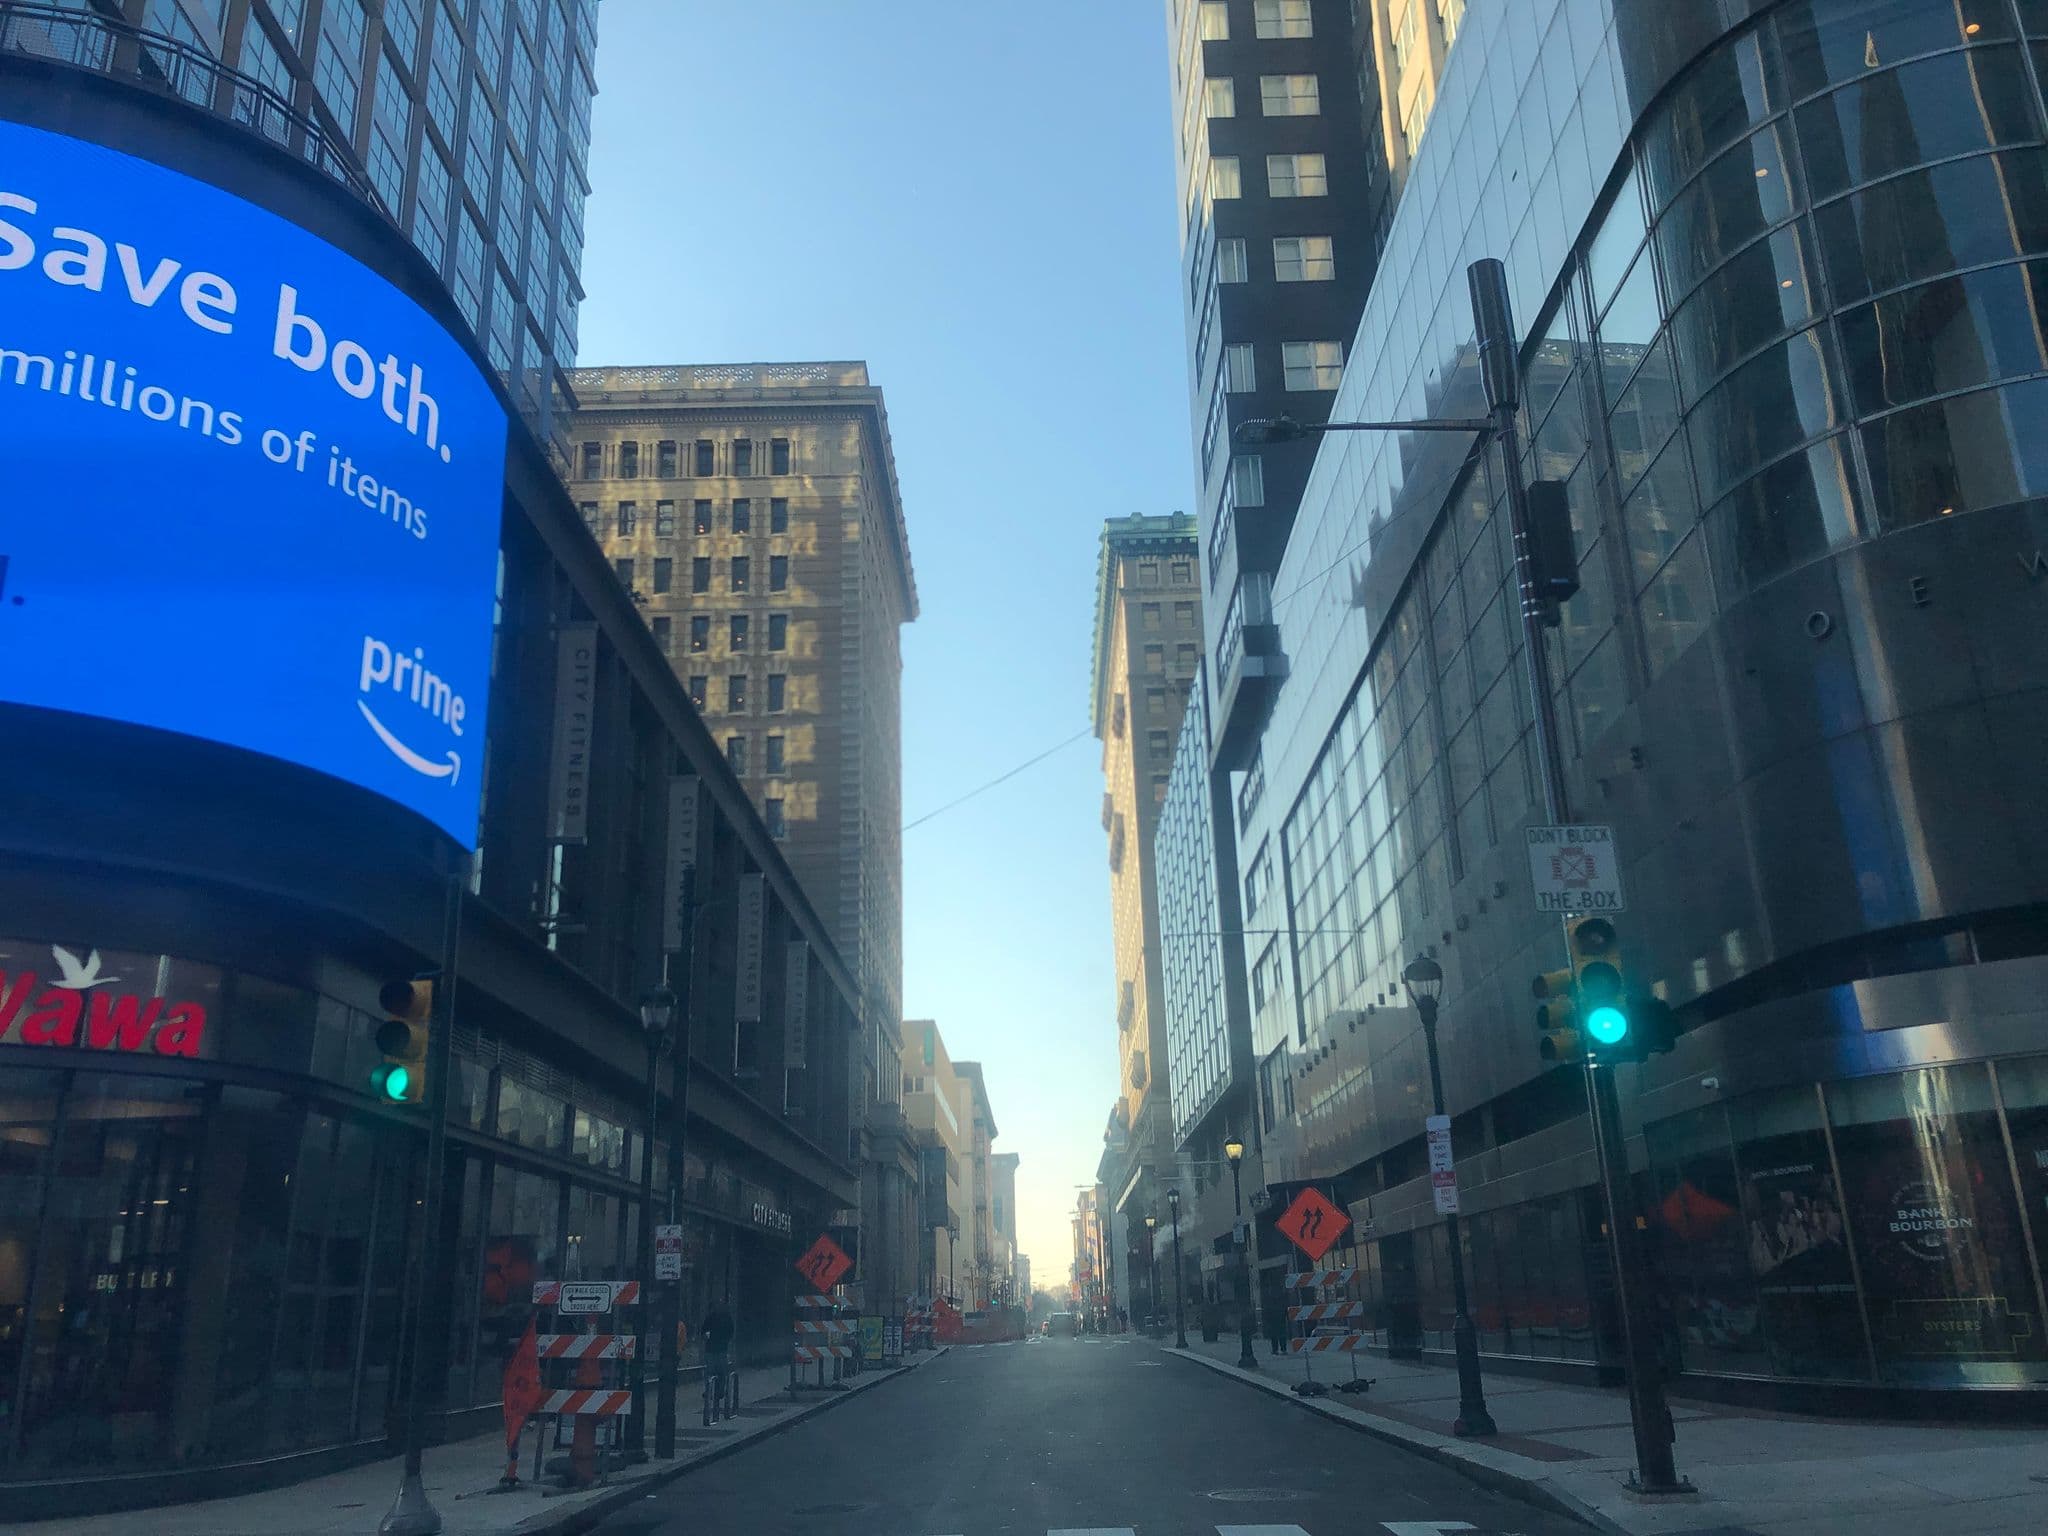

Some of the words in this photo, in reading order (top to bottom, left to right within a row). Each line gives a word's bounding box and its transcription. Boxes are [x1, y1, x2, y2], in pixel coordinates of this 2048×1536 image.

[0, 191, 237, 334] Save
[273, 283, 452, 464] both.
[0, 348, 243, 446] millions
[261, 429, 316, 473] of
[329, 443, 428, 541] items
[361, 636, 466, 737] prime
[575, 648, 590, 703] CITY
[566, 712, 586, 817] FITNESS
[1567, 828, 1610, 843] BLOCK
[1538, 891, 1573, 909] THE
[1581, 889, 1617, 908] BOX
[1889, 1218, 1973, 1232] BOURBON
[1923, 1320, 1982, 1332] OYSTERS
